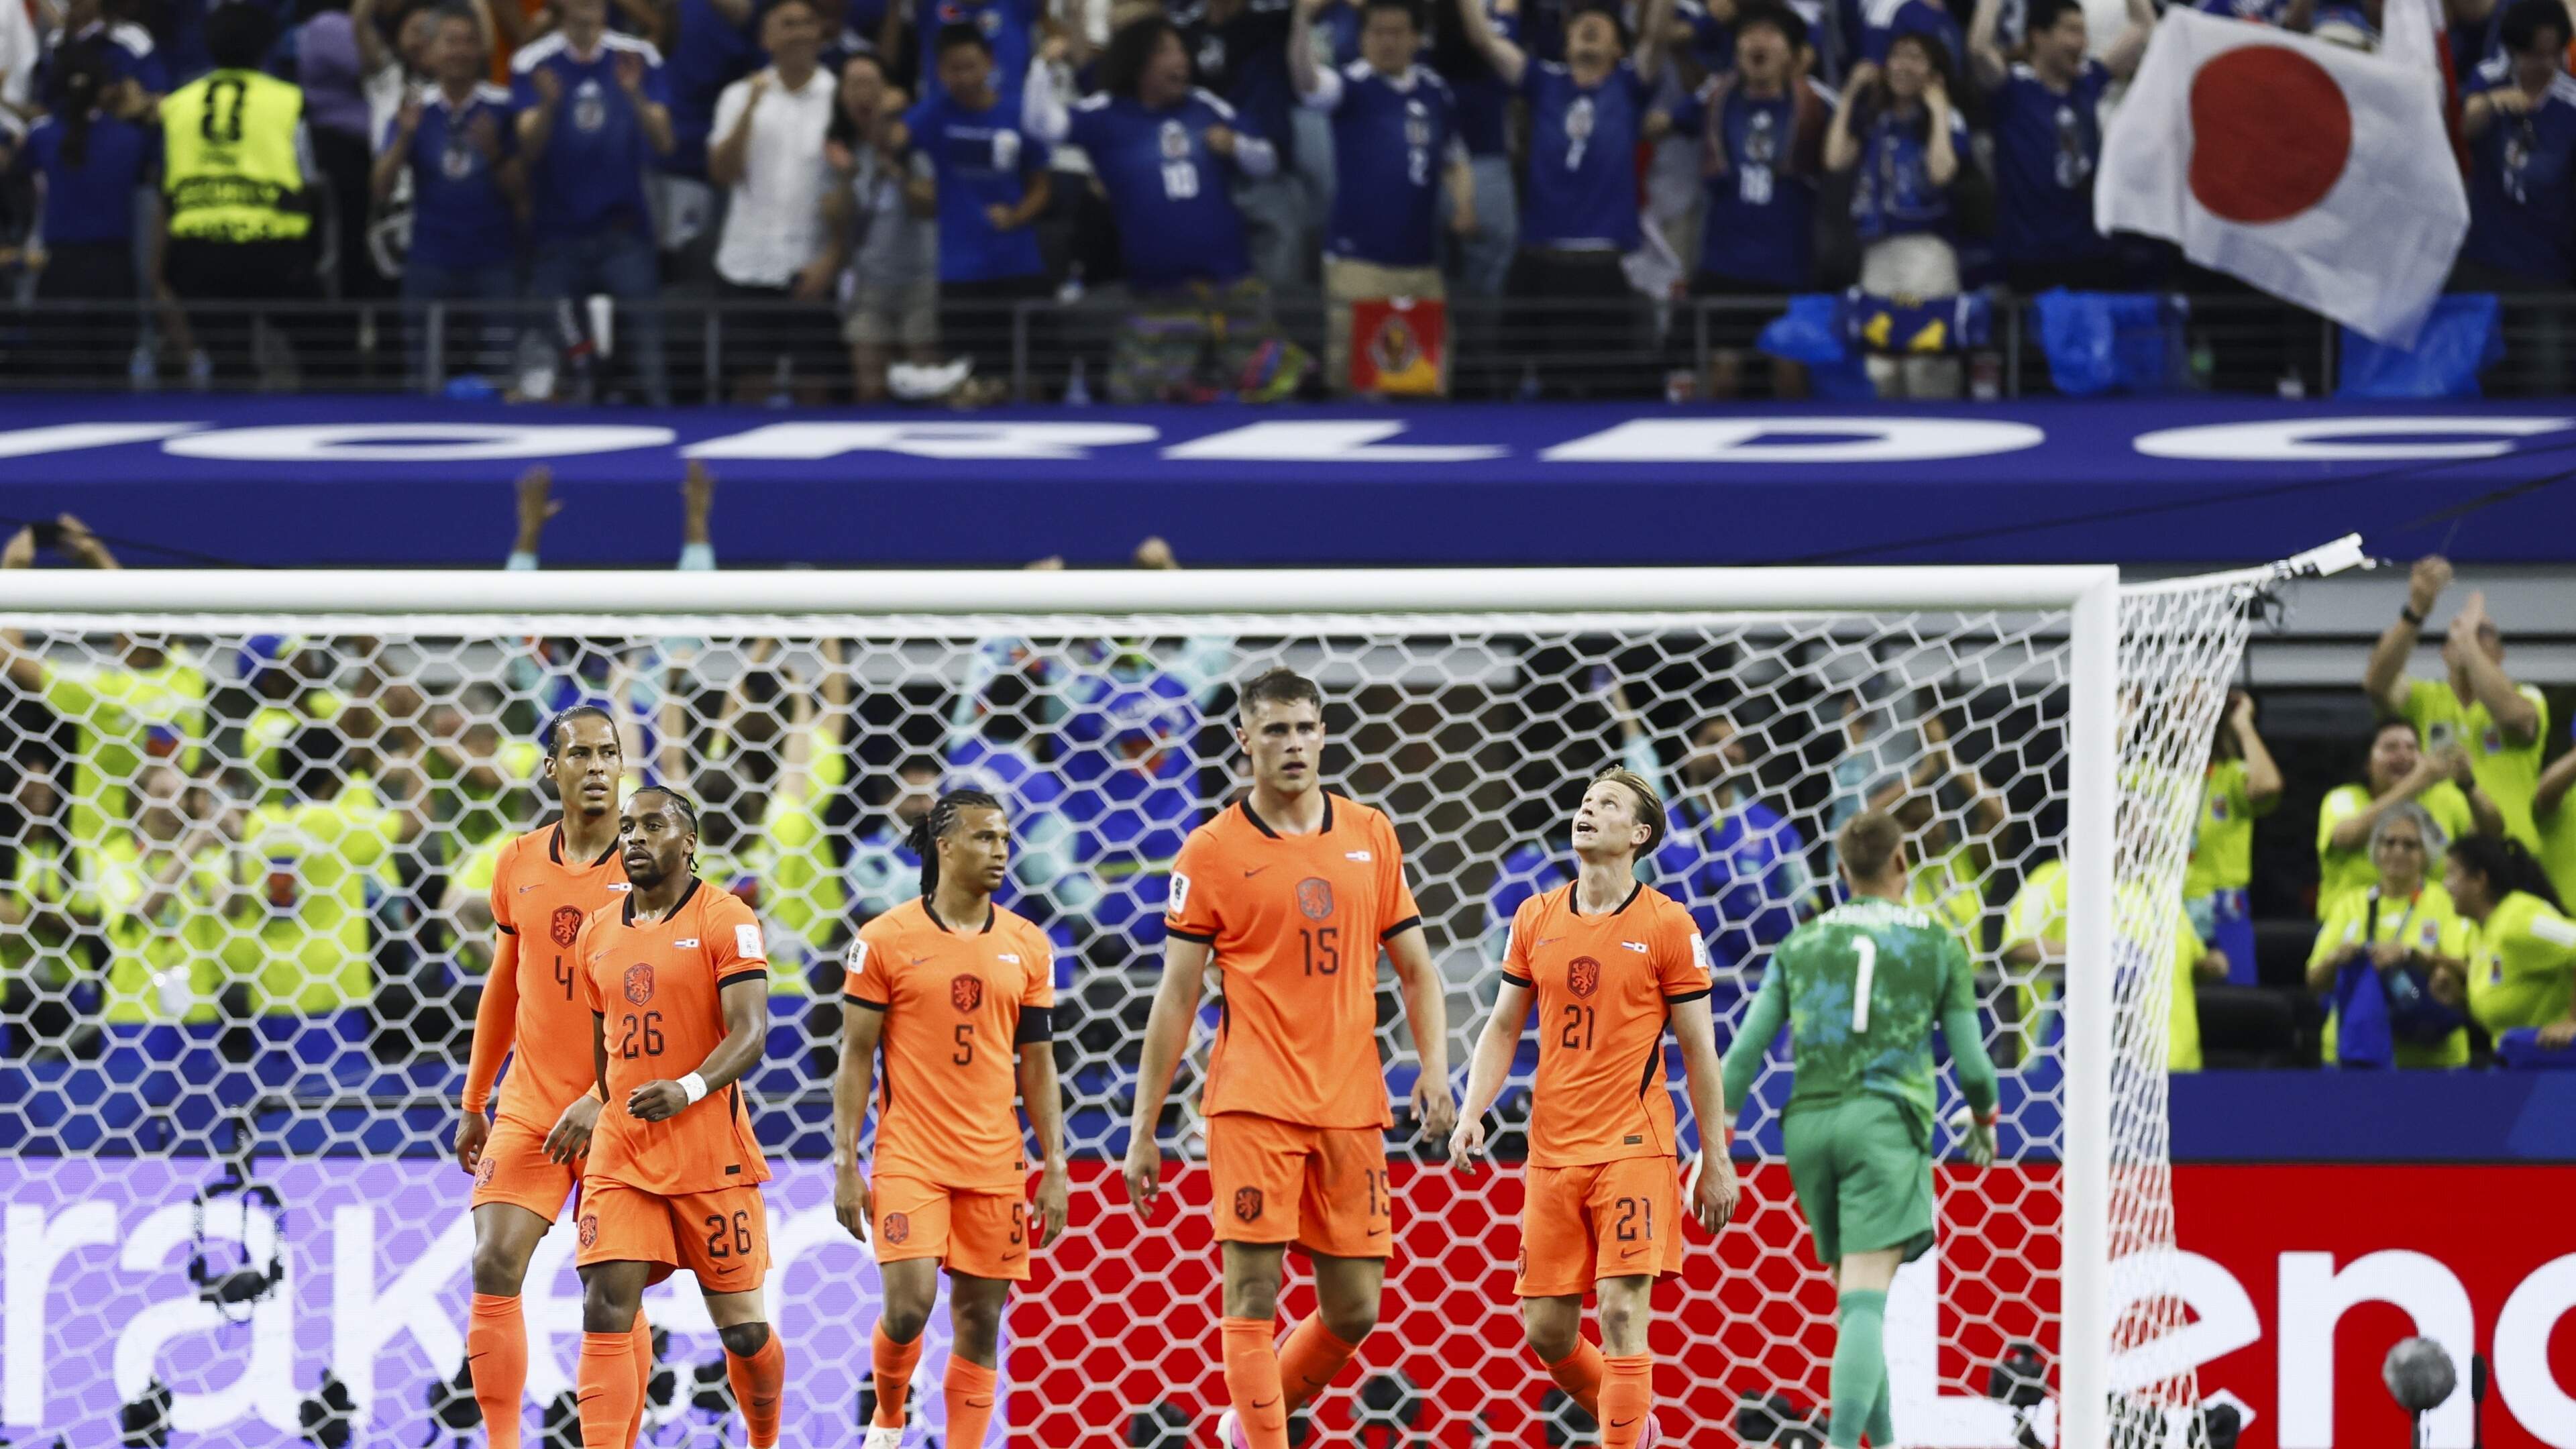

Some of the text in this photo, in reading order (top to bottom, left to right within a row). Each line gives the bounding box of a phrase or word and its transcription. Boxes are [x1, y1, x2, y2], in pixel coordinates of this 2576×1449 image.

[1299, 928, 1338, 976] 15
[555, 955, 574, 1001] 4
[1851, 934, 1877, 1034] 1
[622, 1010, 664, 1060] 26
[953, 1024, 973, 1065] 5
[1562, 1004, 1595, 1051] 21
[705, 1210, 752, 1258] 26
[1010, 1203, 1023, 1244] 5
[1616, 1197, 1652, 1242] 21
